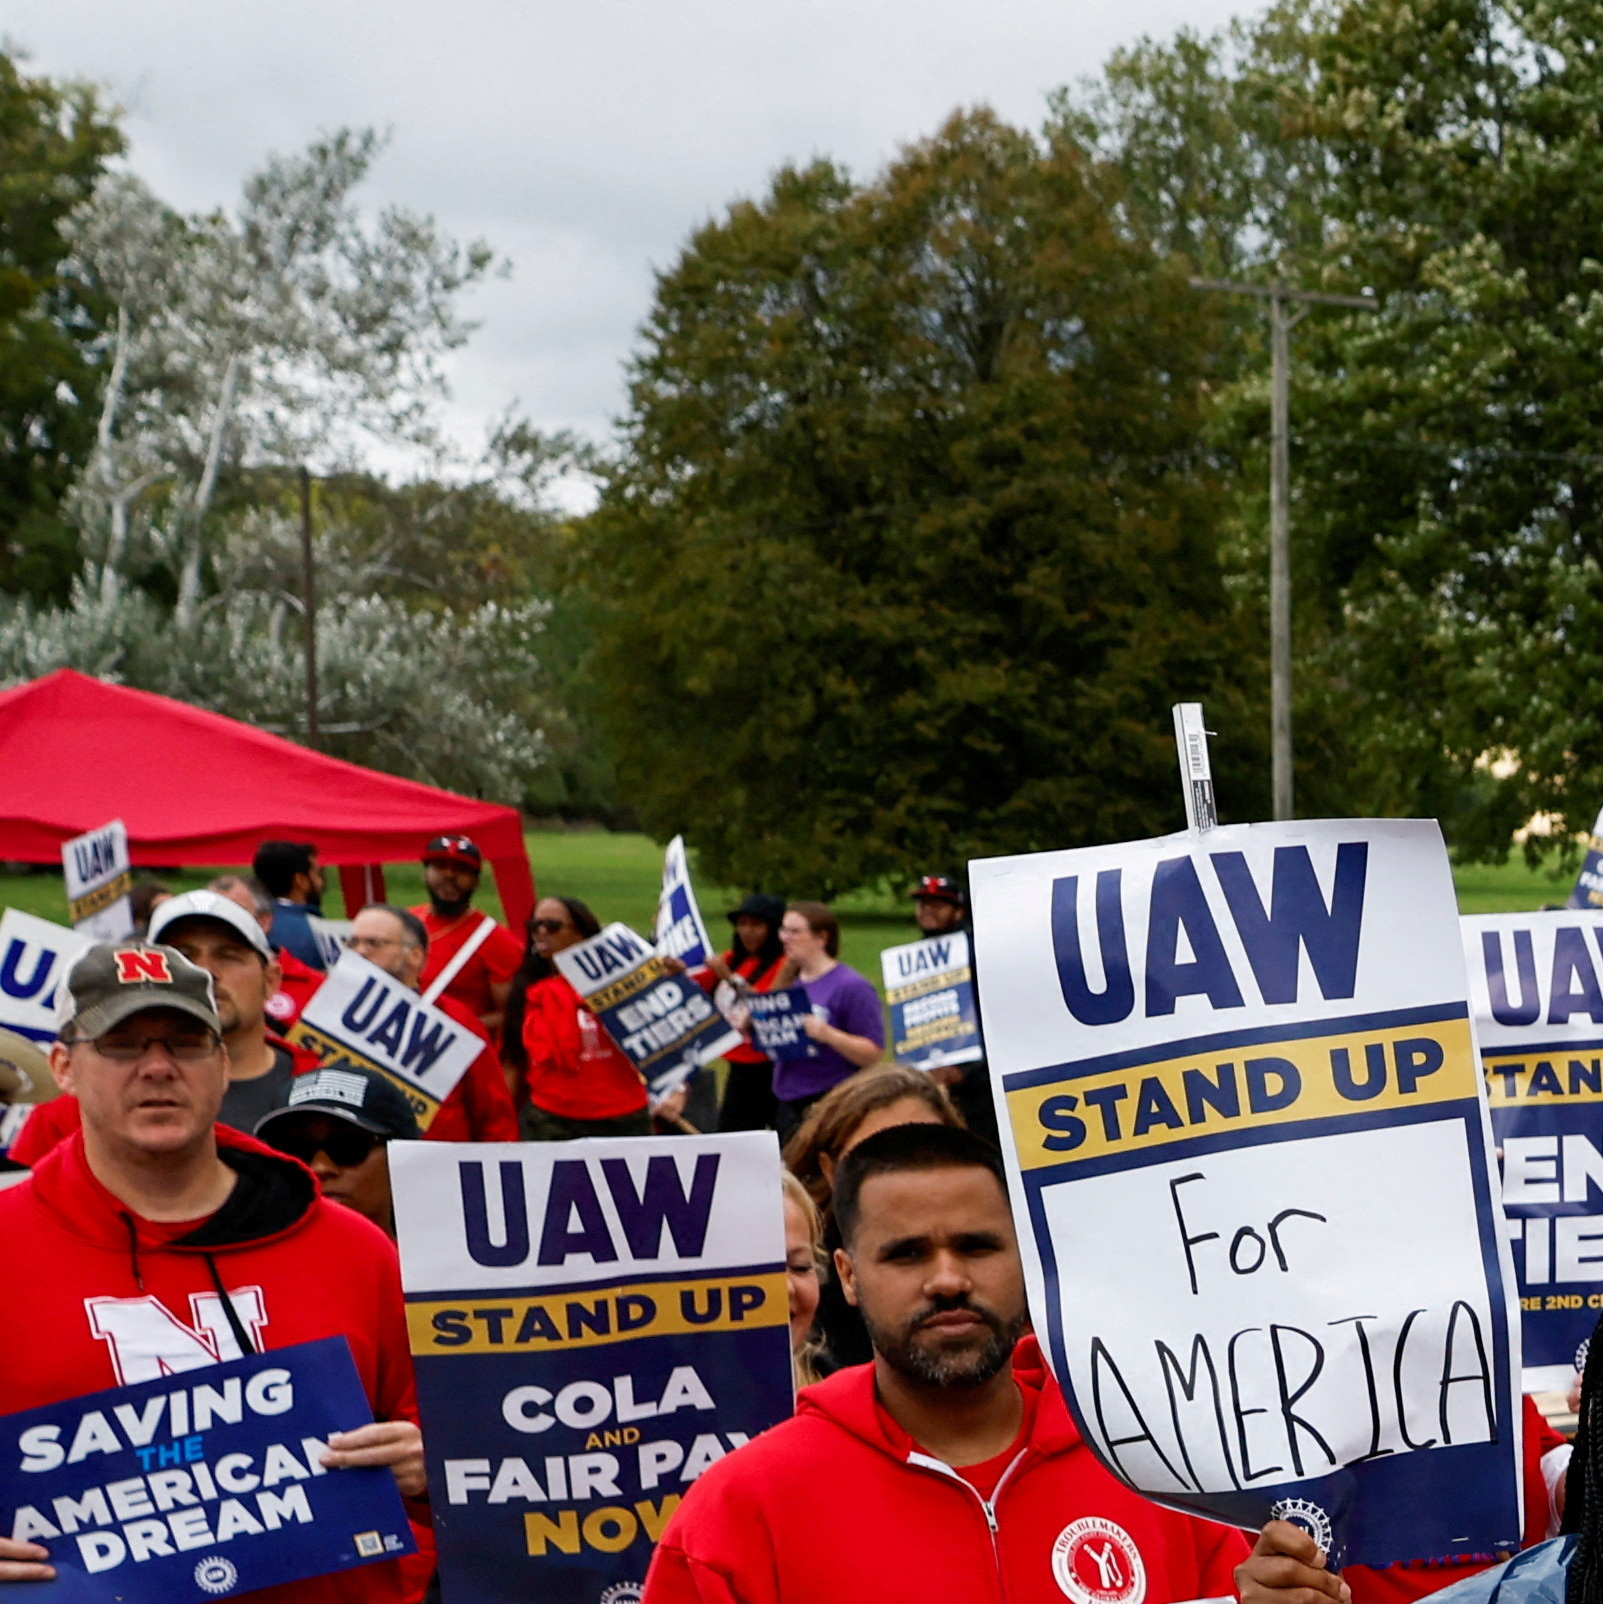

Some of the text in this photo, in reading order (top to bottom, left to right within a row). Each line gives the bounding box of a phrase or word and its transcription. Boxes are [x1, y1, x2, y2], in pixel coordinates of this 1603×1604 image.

[74, 833, 115, 883] UAW
[114, 949, 174, 983] N
[574, 932, 643, 982] UAW
[899, 941, 952, 977] UAW
[1051, 842, 1368, 1027] UAW
[341, 975, 457, 1078] UAW
[617, 981, 683, 1033] END
[622, 993, 714, 1061] TIERS
[1038, 1037, 1444, 1152] STAND UP
[459, 1153, 721, 1268] UAW
[1169, 1172, 1326, 1294] For
[431, 1285, 766, 1347] STAND UP
[1545, 1295, 1583, 1310] 2ND
[84, 1285, 268, 1386] N
[19, 1368, 293, 1474] SAVING
[501, 1366, 716, 1434] COLA
[1090, 1300, 1499, 1493] AMERICA
[136, 1436, 204, 1471] THE
[584, 1427, 641, 1450] AND
[443, 1452, 623, 1505] FAIR
[75, 1485, 314, 1574] DREAM
[1055, 1519, 1137, 1560] TROUBLEMAKERS
